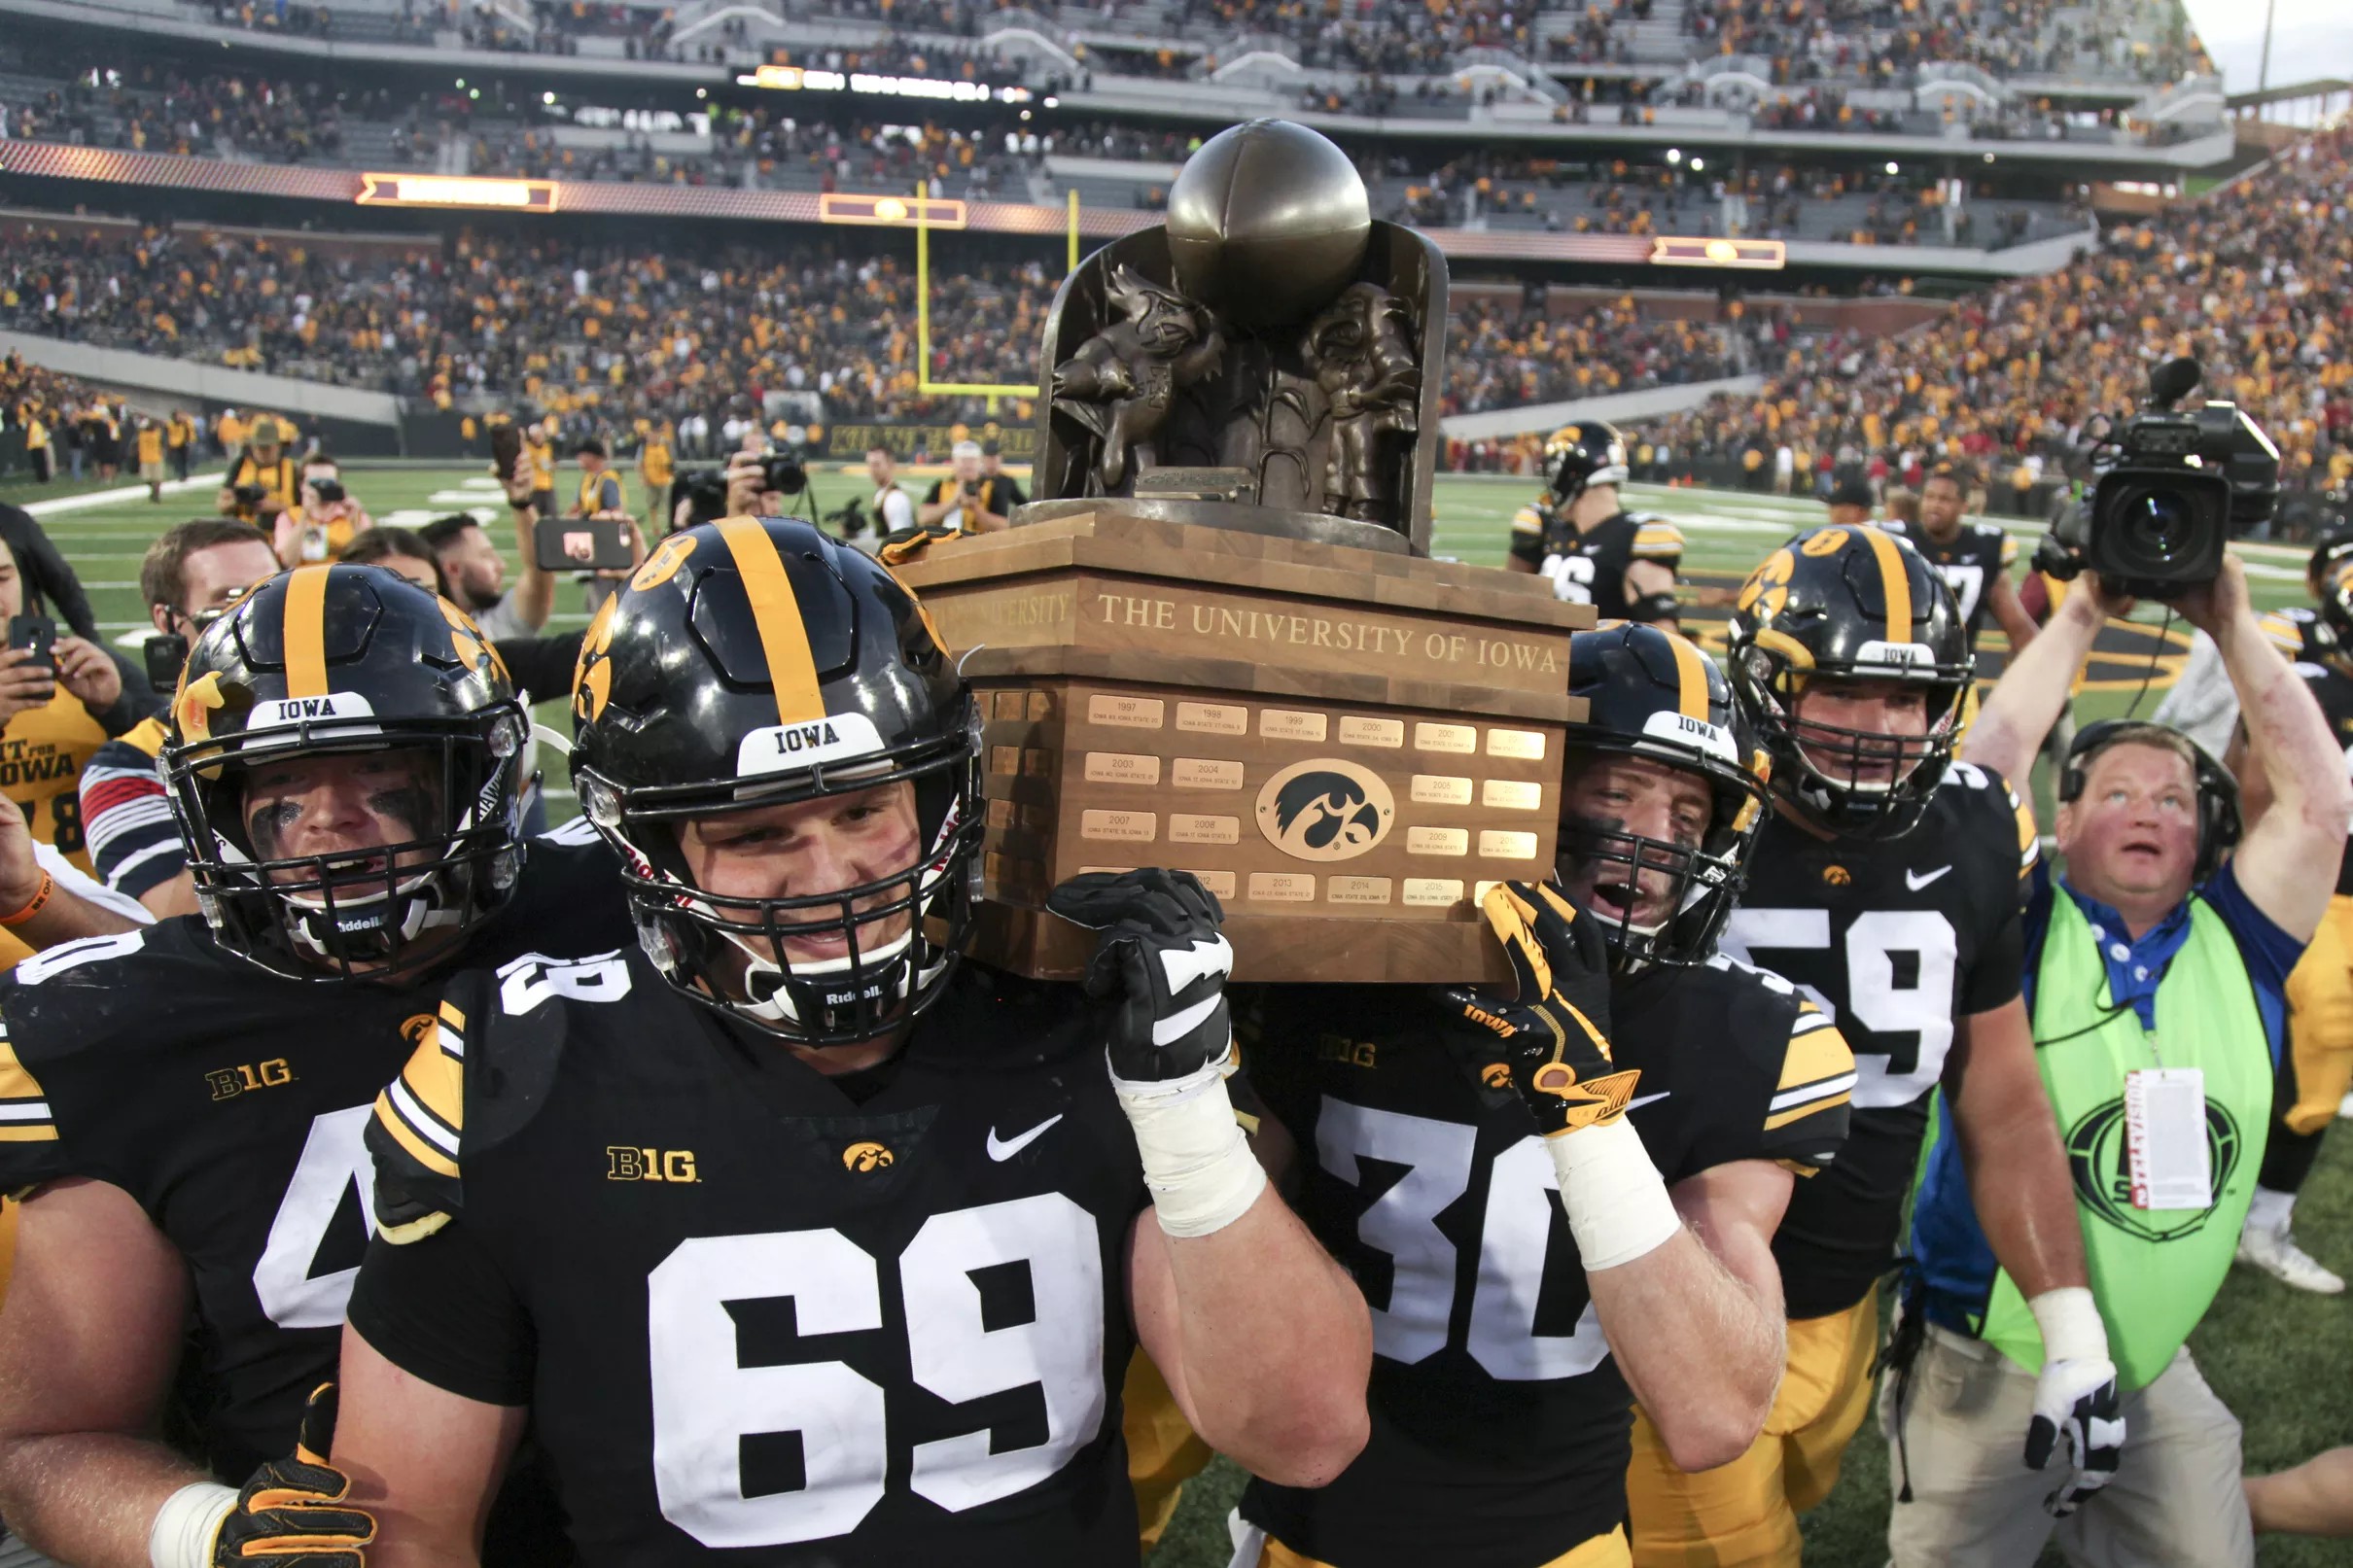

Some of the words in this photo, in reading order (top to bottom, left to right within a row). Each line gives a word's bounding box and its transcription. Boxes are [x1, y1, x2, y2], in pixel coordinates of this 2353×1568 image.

[1098, 594, 1176, 630] THE
[1192, 606, 1414, 656] UNIVERSITY
[1425, 634, 1466, 662] OF
[1477, 640, 1558, 674] IOWA
[1883, 647, 1916, 663] IOWA
[278, 698, 336, 720] IOWA
[1118, 703, 1136, 712] 1997
[1204, 709, 1221, 718] 1998
[1285, 715, 1303, 724] 1999
[1678, 715, 1719, 742] IOWA
[774, 722, 840, 754] IOWA
[1438, 729, 1454, 738] 2001
[1112, 759, 1134, 768] 2003
[1198, 764, 1218, 774] 2004
[1433, 781, 1451, 789] 2005
[1109, 816, 1130, 824] 2007
[1194, 820, 1214, 829] 2008
[1198, 876, 1211, 885] 012
[1351, 881, 1369, 889] 2014
[1424, 882, 1443, 890] 2015
[31, 897, 44, 911] BE
[339, 916, 379, 932] iddell
[1462, 1004, 1518, 1038] IOWA
[1316, 1093, 1611, 1381] 30
[649, 1192, 1106, 1549] 69
